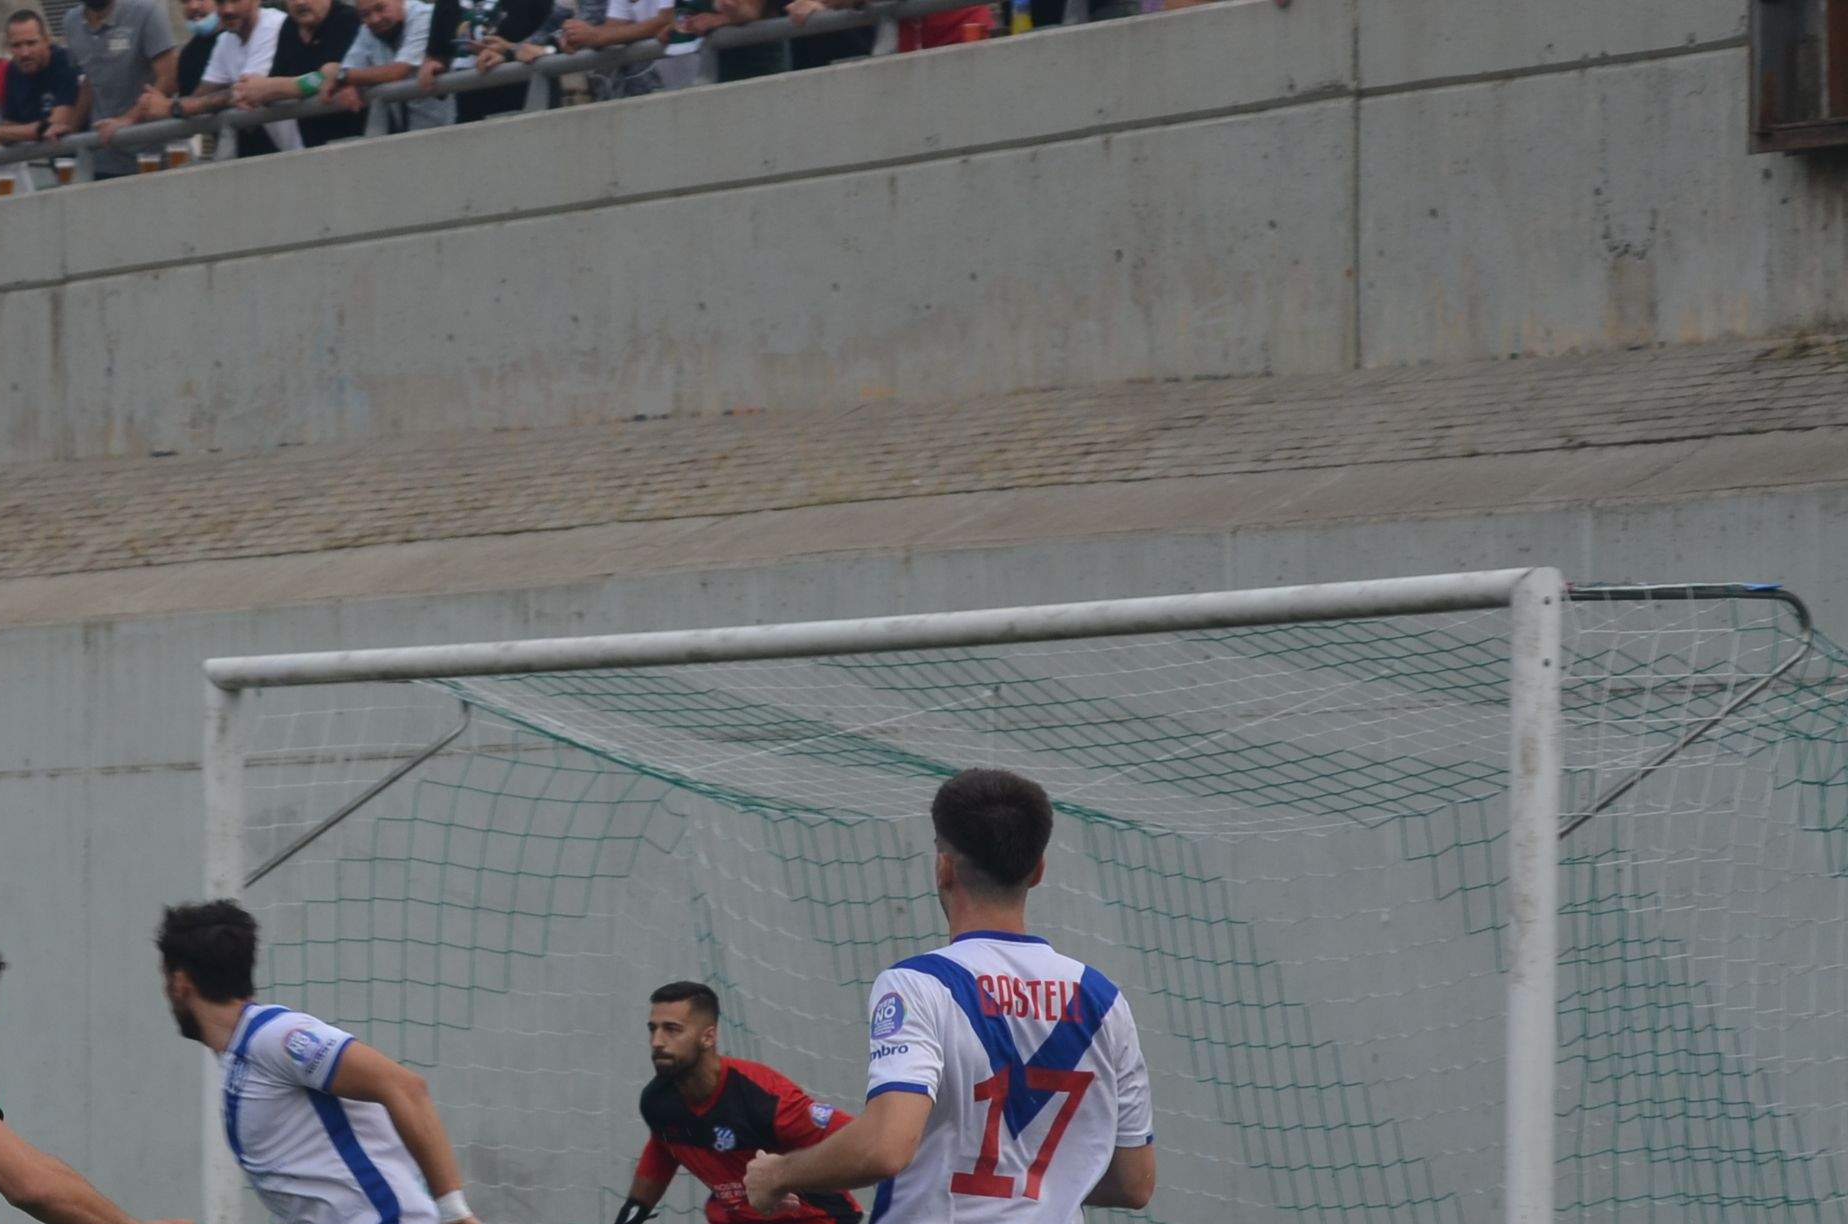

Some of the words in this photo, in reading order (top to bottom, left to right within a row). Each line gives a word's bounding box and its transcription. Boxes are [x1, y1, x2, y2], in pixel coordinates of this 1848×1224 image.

[874, 1005, 897, 1025] NO
[870, 1045, 909, 1061] mbro
[950, 1065, 1095, 1200] 17
